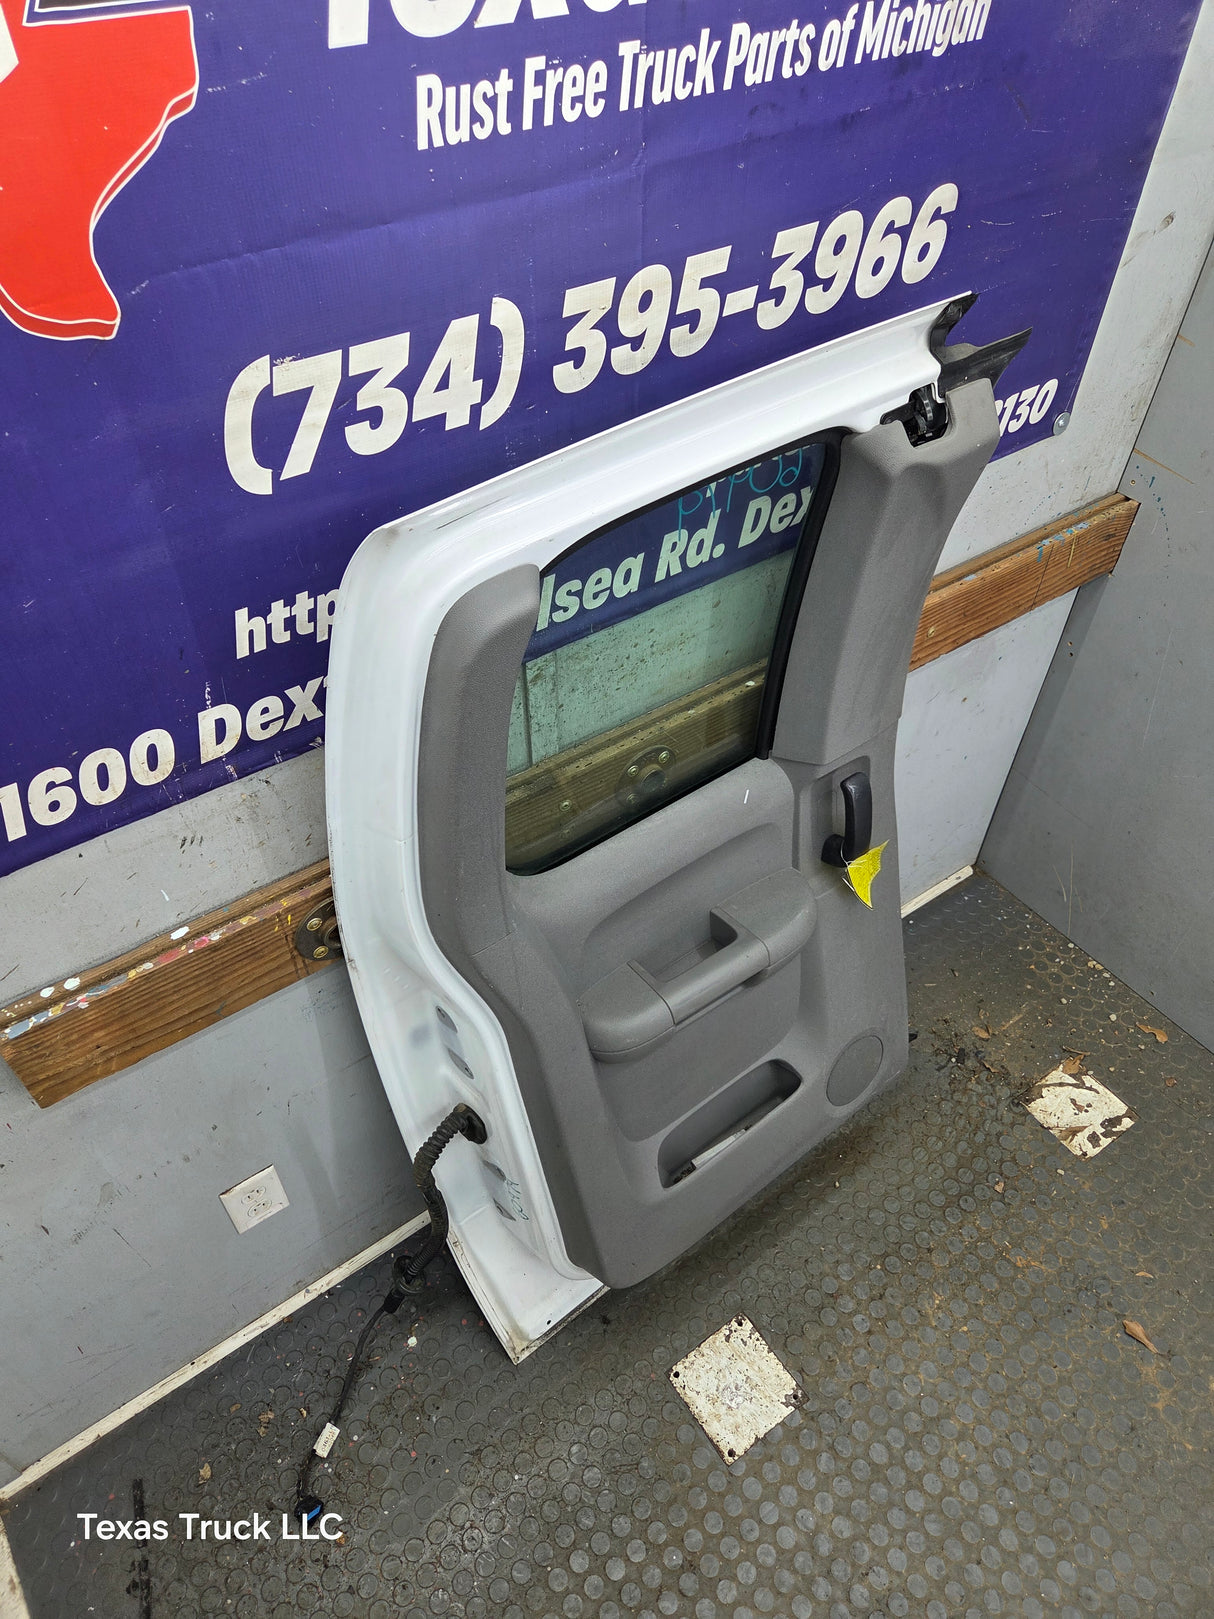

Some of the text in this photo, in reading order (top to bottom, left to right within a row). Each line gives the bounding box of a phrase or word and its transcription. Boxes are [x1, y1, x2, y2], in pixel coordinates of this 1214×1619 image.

[416, 69, 513, 151] Rust
[522, 55, 608, 131] Free
[618, 28, 721, 112] Truck
[723, 19, 815, 91] Parts
[818, 2, 858, 71] of
[854, 0, 993, 65] Michigan
[224, 183, 959, 495] (734) 395-3966
[198, 674, 330, 765] Dex
[654, 508, 725, 583] Rd.
